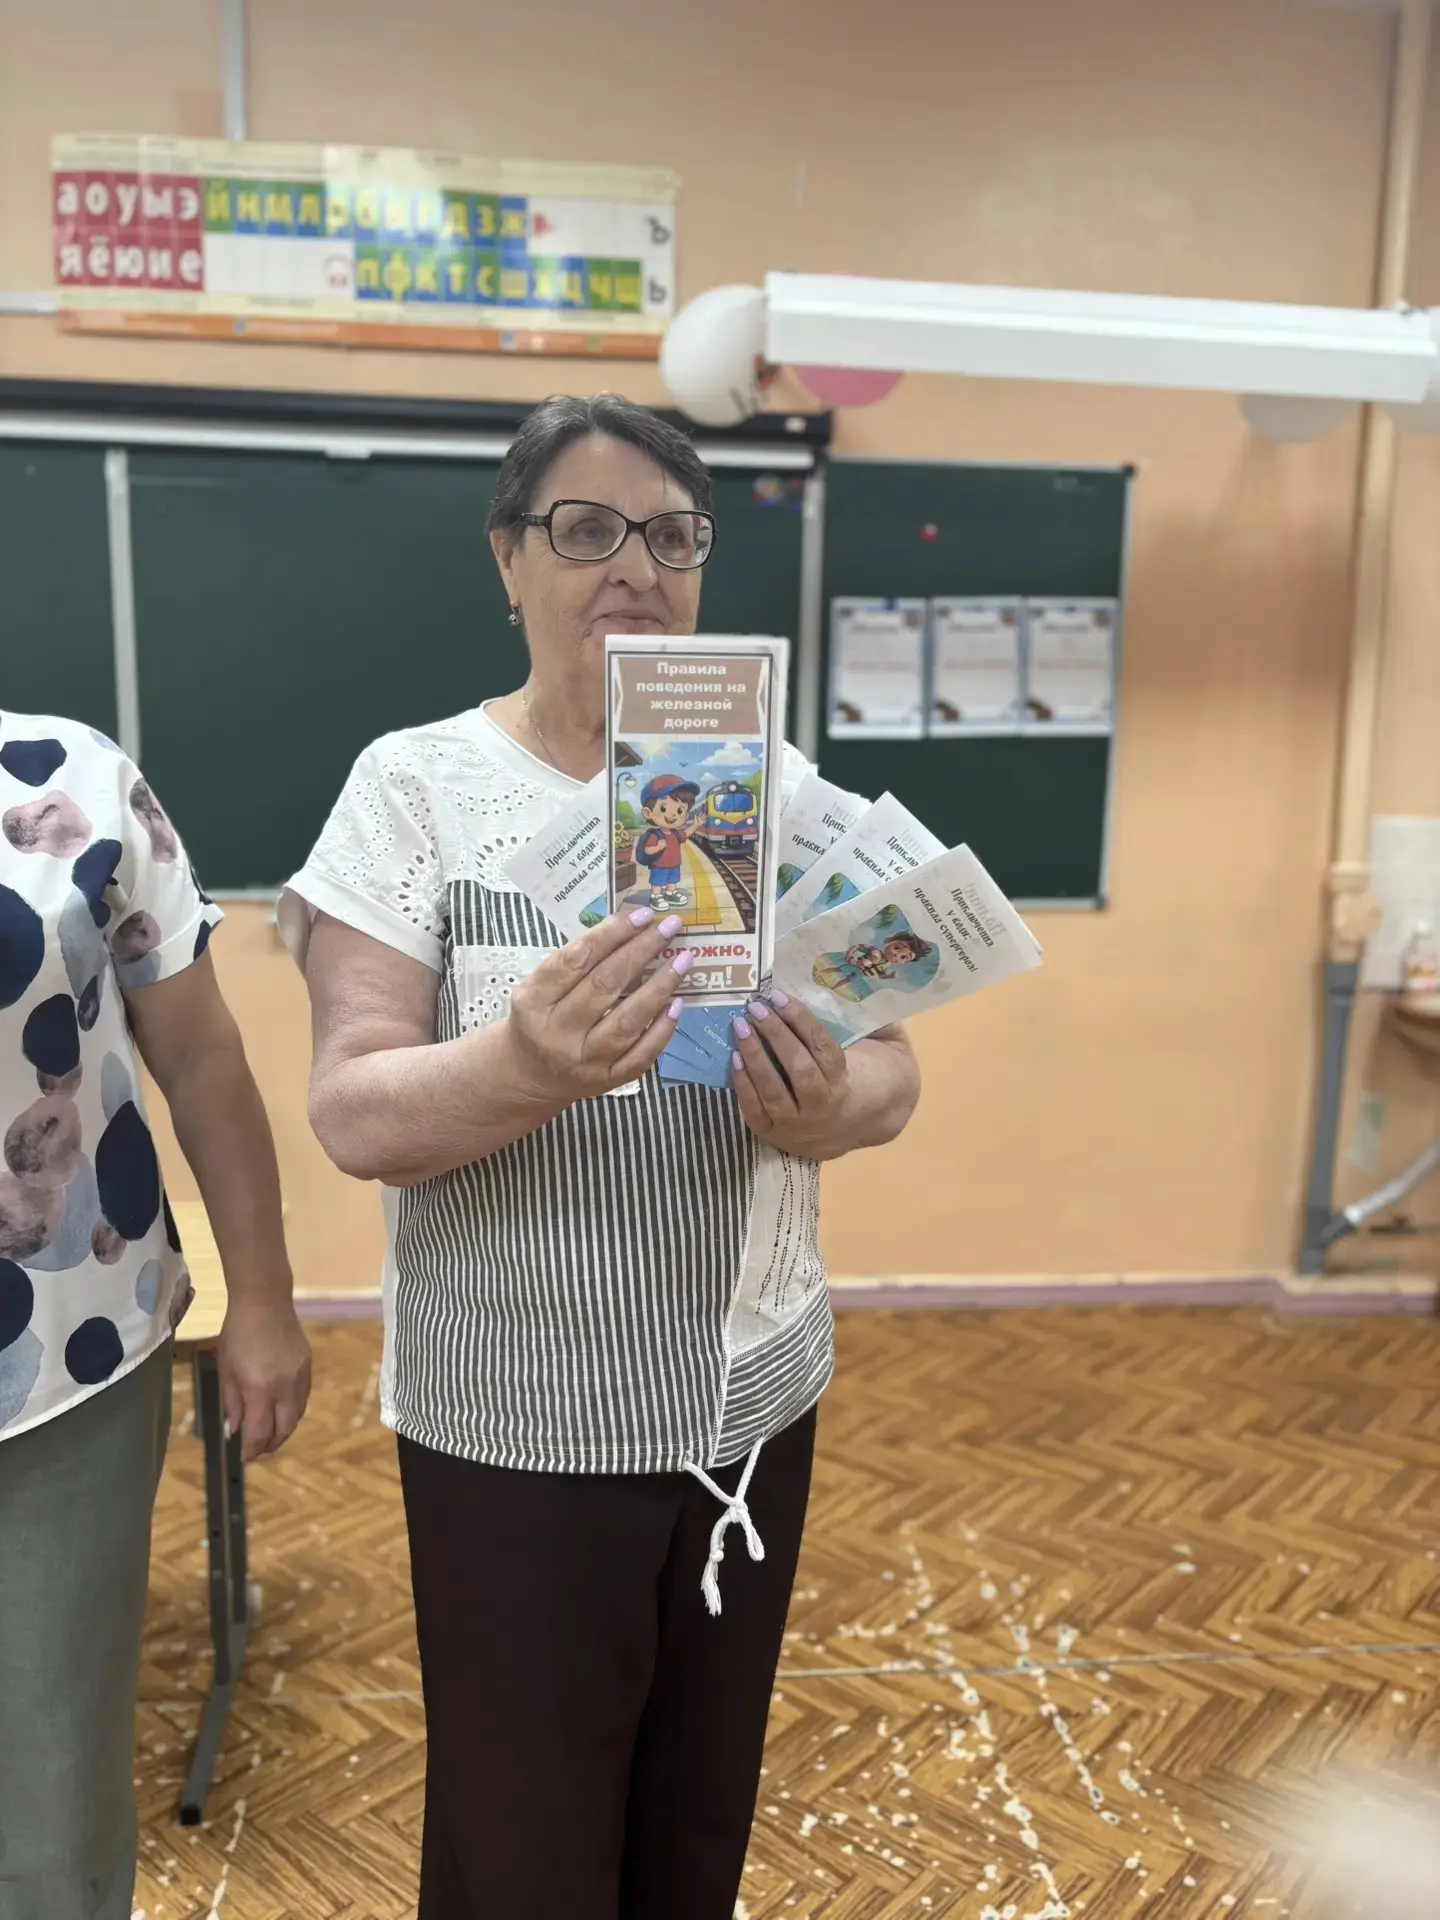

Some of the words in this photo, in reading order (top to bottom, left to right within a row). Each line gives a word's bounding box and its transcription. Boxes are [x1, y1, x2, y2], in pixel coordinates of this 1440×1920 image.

[657, 661, 727, 677] Правила
[636, 682, 722, 695] поведения
[727, 683, 746, 694] на
[650, 699, 732, 711] железной
[663, 718, 719, 730] дороге
[822, 813, 848, 834] Прик
[544, 816, 601, 869] Приключения
[792, 834, 826, 856] правил
[886, 836, 919, 868] Приклю
[569, 860, 578, 869] у
[852, 847, 886, 878] правила
[554, 869, 588, 903] правила
[587, 848, 608, 871] супе
[946, 909, 956, 917] у
[951, 888, 994, 948] Приключения
[914, 887, 942, 924] правила
[939, 924, 979, 973] супергероя!
[703, 1025, 727, 1047] Смотри
